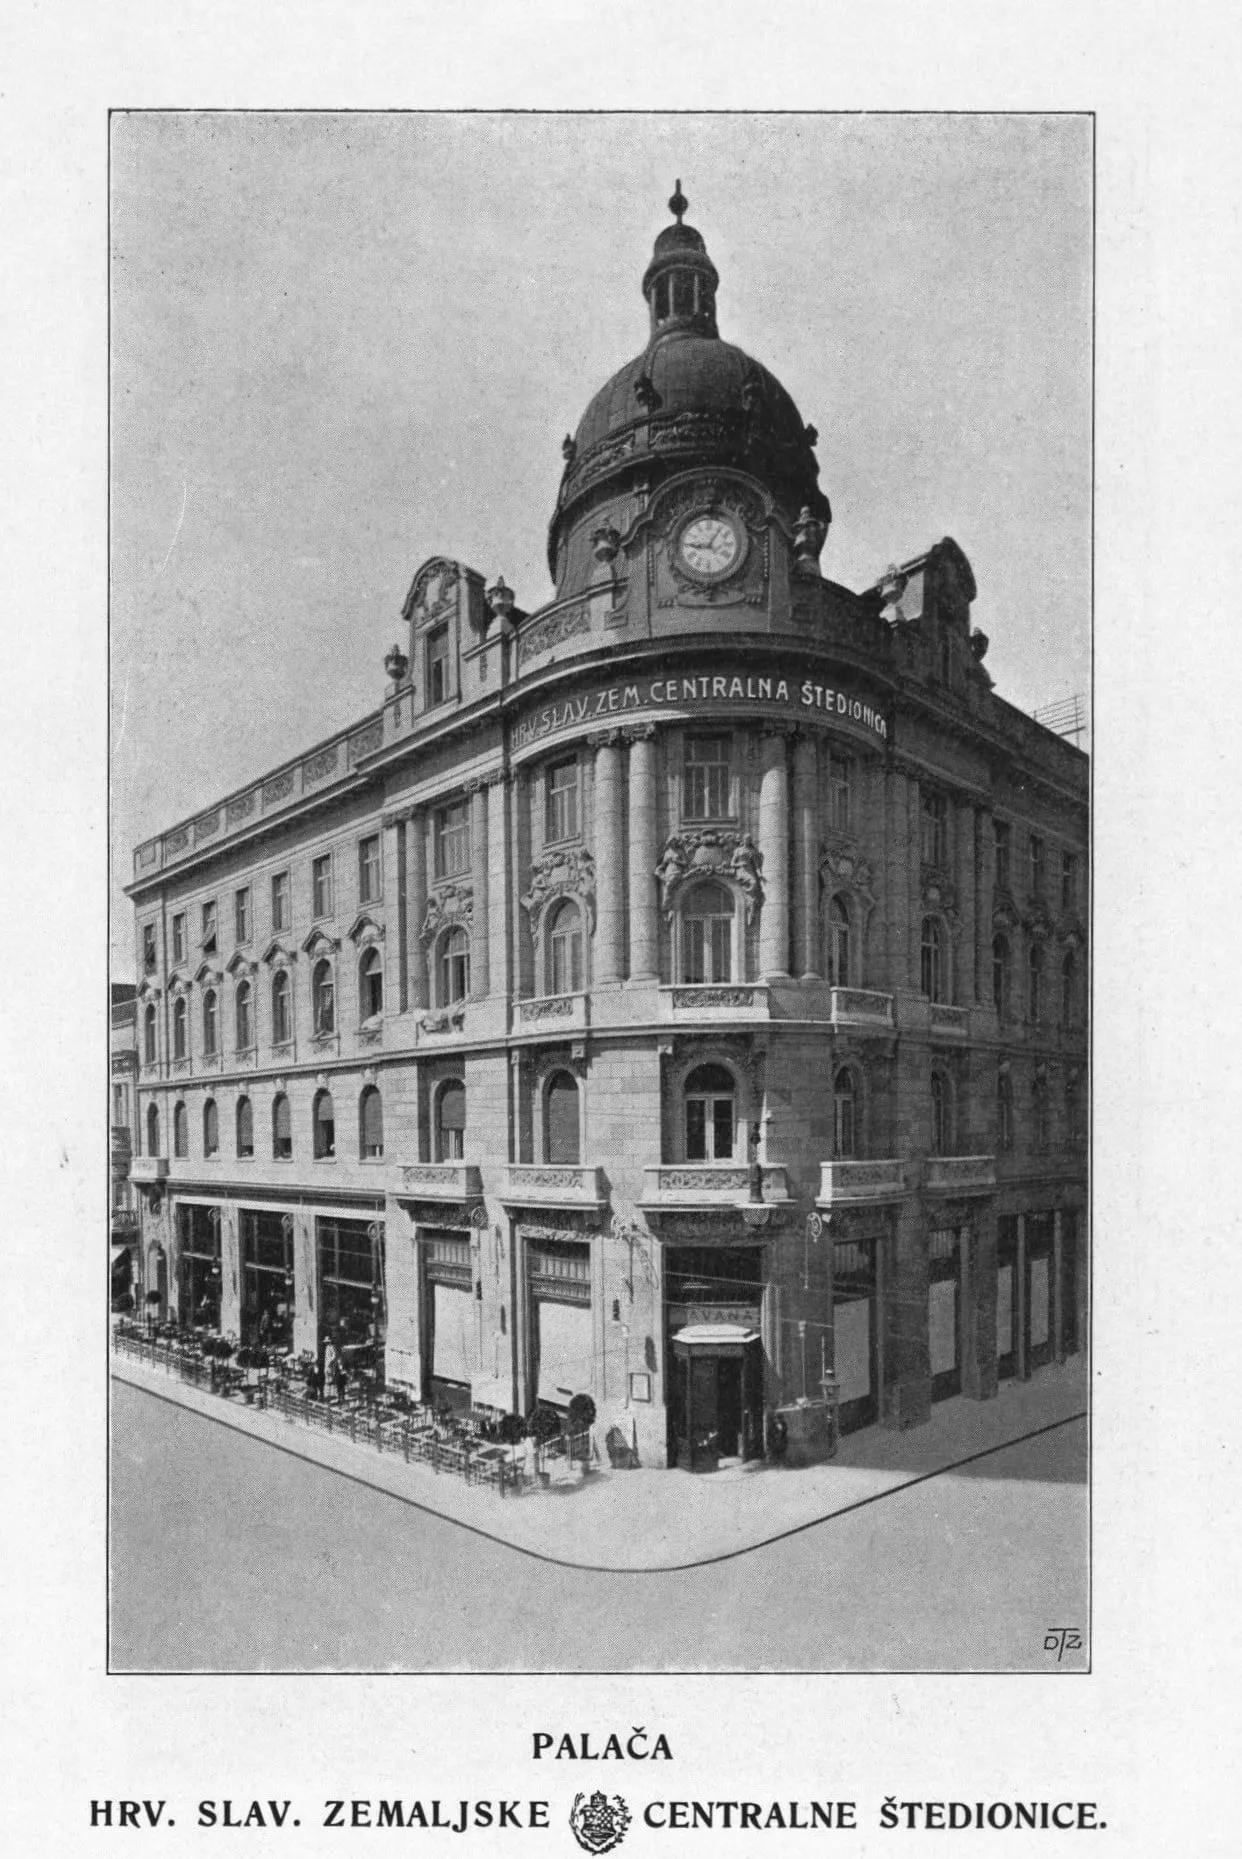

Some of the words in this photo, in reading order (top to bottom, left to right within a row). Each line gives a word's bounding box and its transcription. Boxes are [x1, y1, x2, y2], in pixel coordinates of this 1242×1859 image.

[596, 685, 648, 713] ZEM.
[650, 676, 789, 701] CENTRALNA
[801, 680, 887, 739] ŠTEDIONICA
